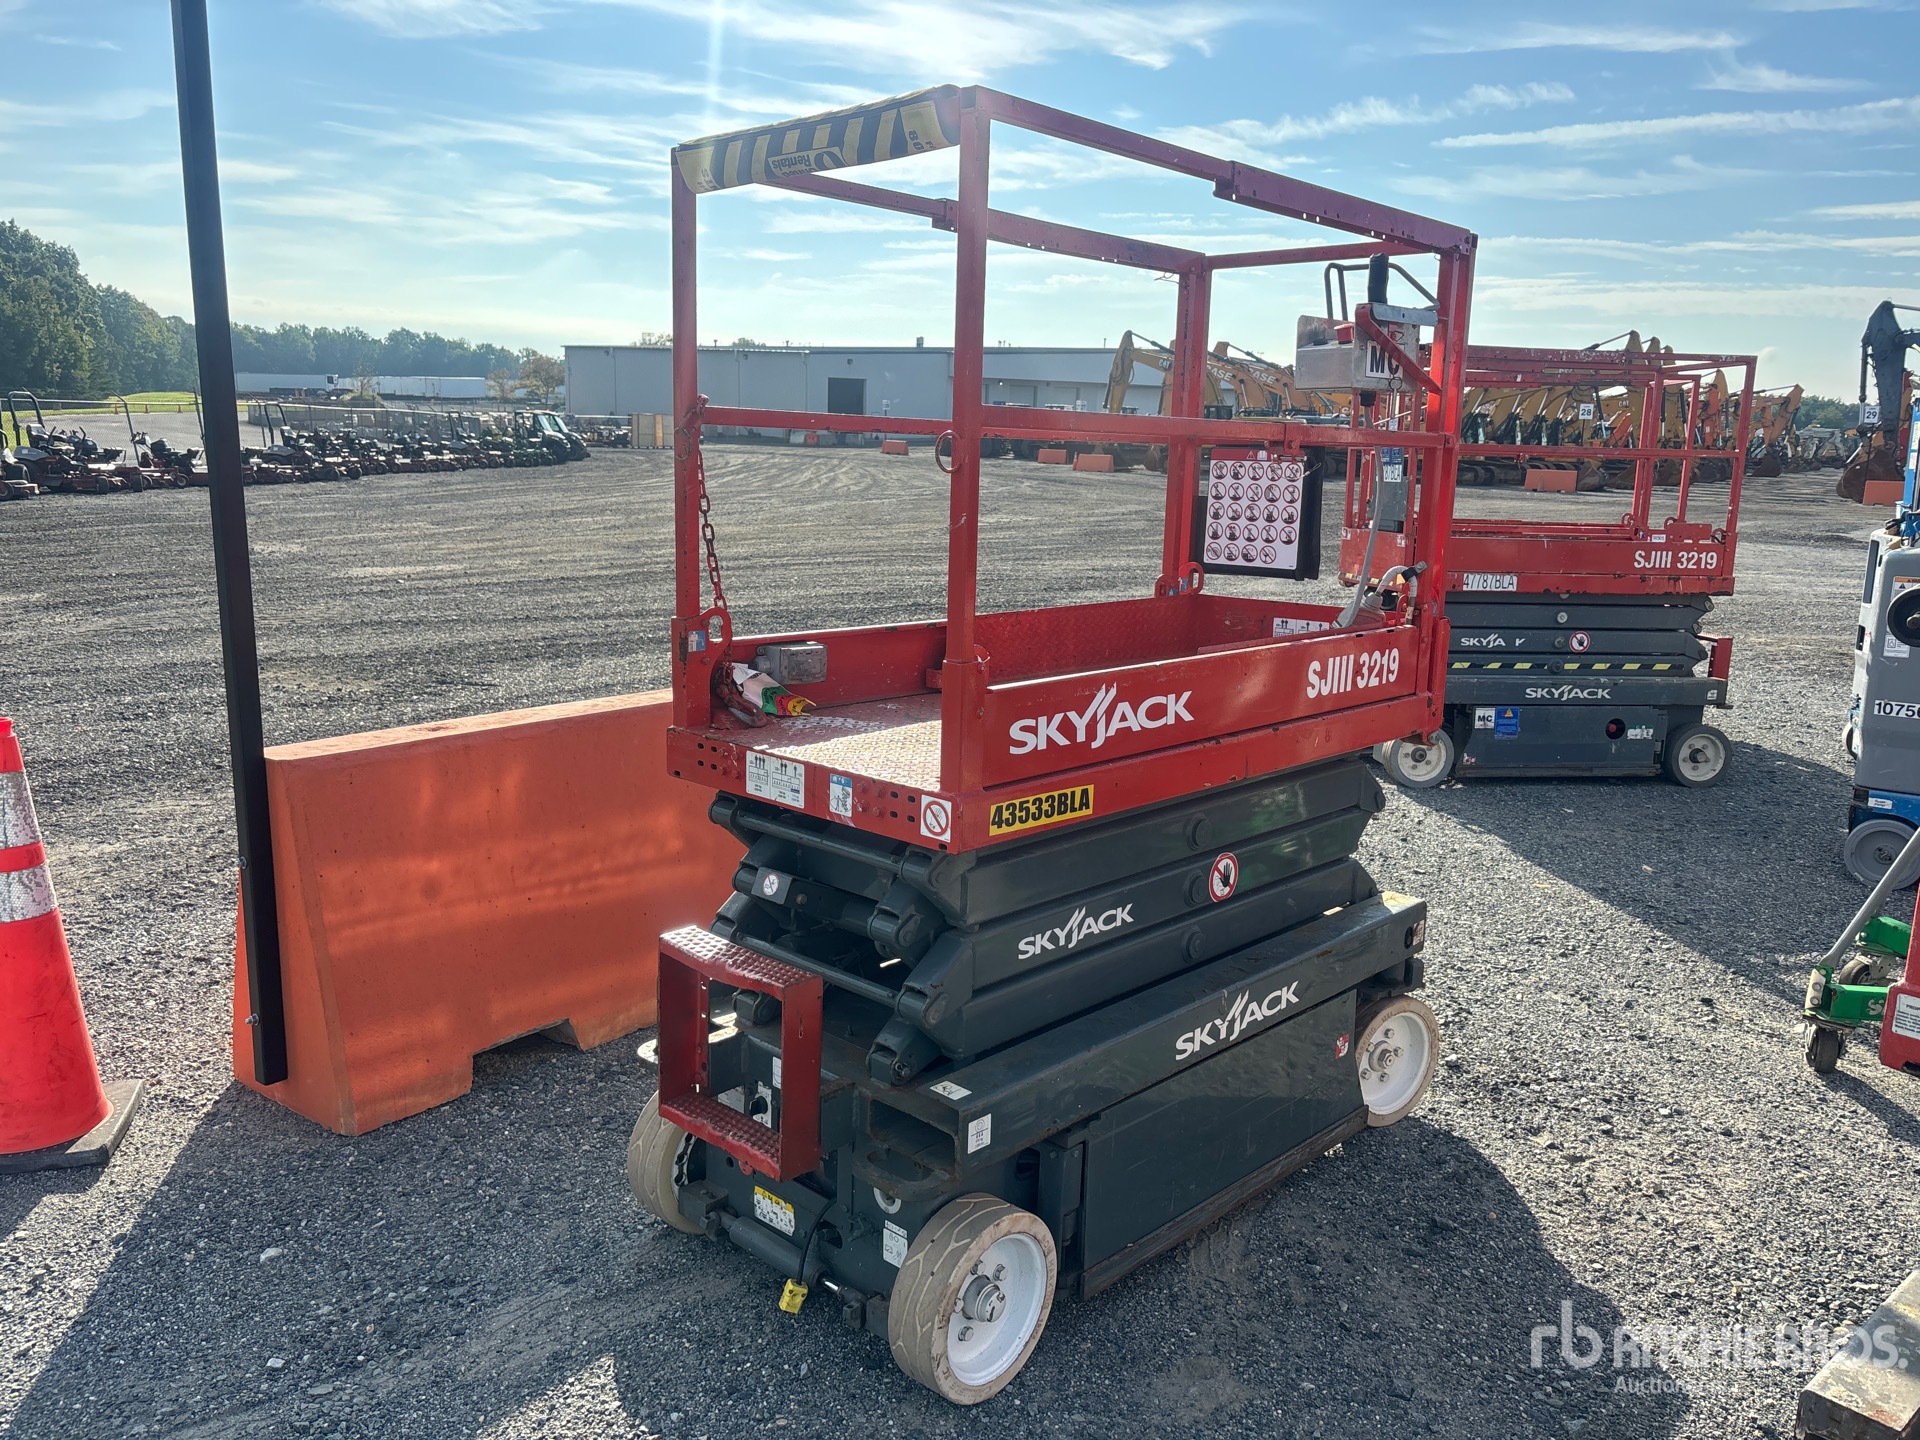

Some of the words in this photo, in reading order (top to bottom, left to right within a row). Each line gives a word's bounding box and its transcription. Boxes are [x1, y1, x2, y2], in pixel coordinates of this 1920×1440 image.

[771, 154, 812, 171] Rentals
[1158, 358, 1171, 370] CAT
[1866, 411, 1877, 419] 29
[1676, 551, 1717, 569] 3219
[1463, 573, 1514, 589] 47787BLA
[1306, 654, 1354, 699] SJIII
[1356, 648, 1399, 689] 3219
[1525, 685, 1611, 701] SKYJACK
[1009, 681, 1195, 755] SKYJACK
[1477, 715, 1493, 723] MC
[990, 788, 1090, 829] 43533BLA
[1018, 903, 1135, 960] SKYJACK
[1175, 980, 1300, 1061] SKYJACK
